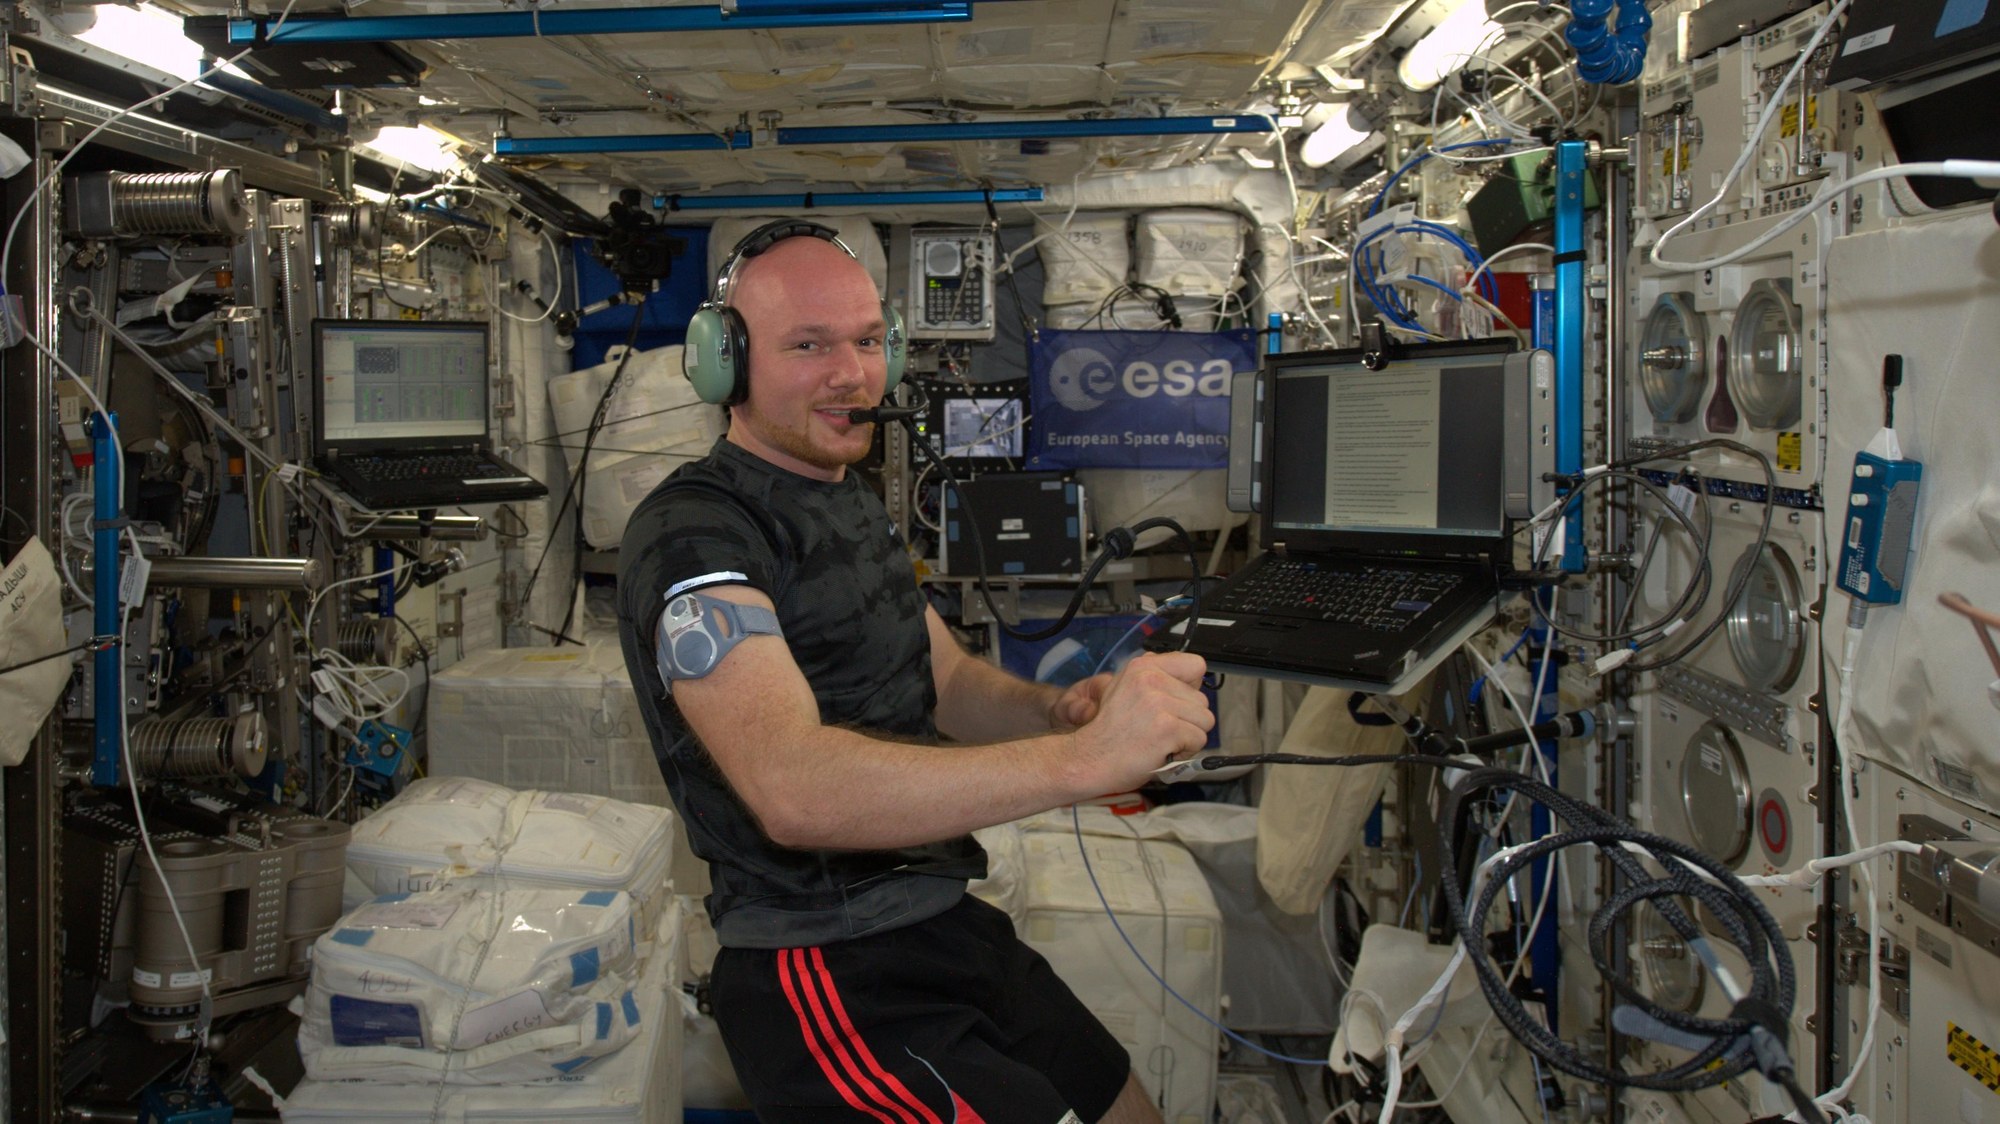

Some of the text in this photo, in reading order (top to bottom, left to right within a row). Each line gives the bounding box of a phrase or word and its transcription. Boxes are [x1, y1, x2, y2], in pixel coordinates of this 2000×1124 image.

[1122, 359, 1232, 398] esa
[1048, 431, 1229, 447] European Space Agency
